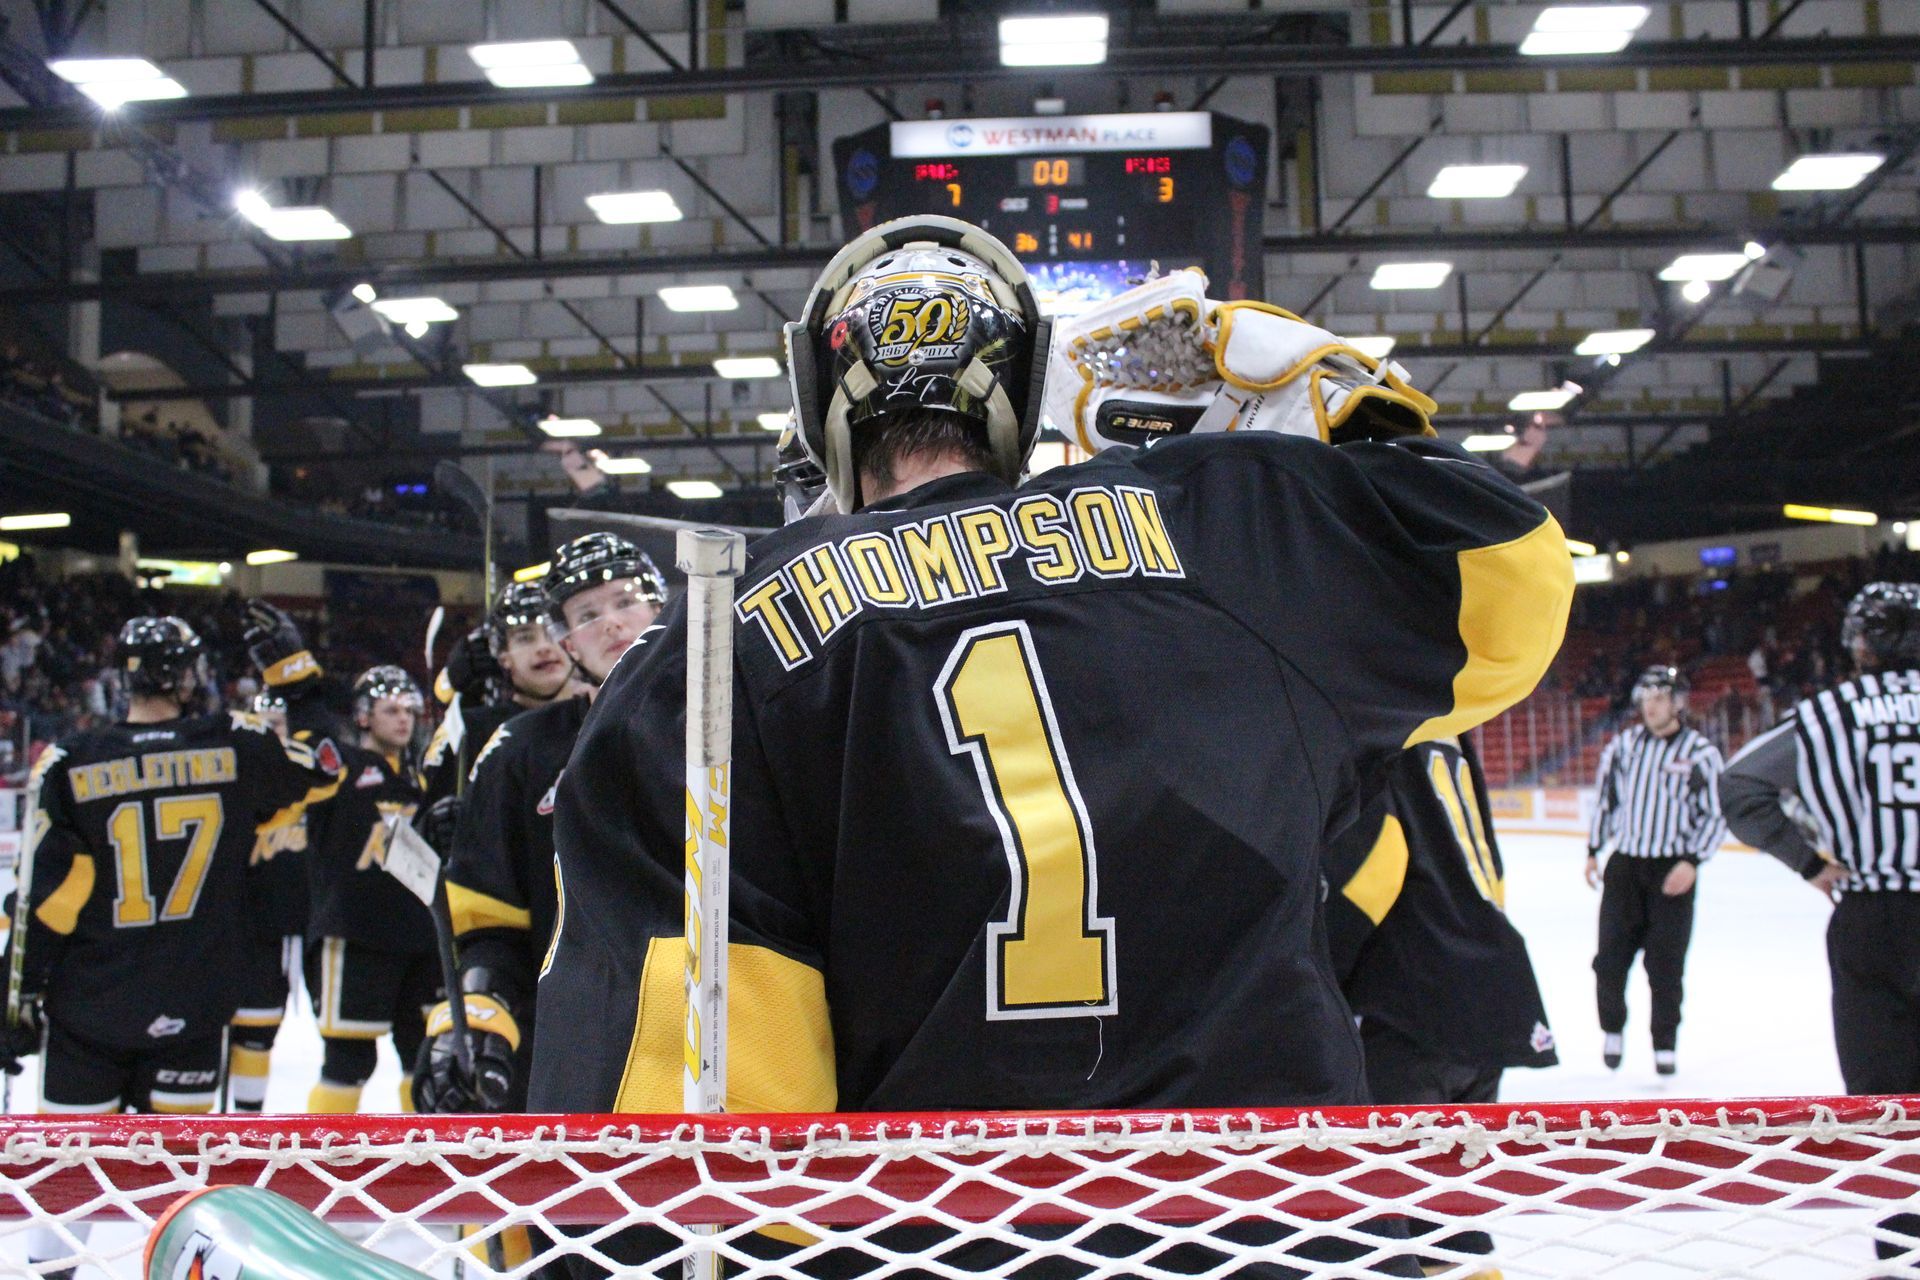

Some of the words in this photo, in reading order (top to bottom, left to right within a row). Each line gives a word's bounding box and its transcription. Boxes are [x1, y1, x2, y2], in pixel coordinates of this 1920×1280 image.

[984, 127, 1097, 145] WESTMAN
[1103, 127, 1156, 141] PLACE
[947, 183, 962, 207] 7
[1158, 176, 1175, 203] 3
[870, 293, 893, 336] WHEAT
[879, 297, 952, 348] 50
[881, 345, 908, 358] 1967
[920, 346, 949, 357] 2017
[715, 538, 738, 577] 1
[733, 485, 1186, 672] THOMPSON
[1850, 693, 1920, 728] MAHO
[1868, 742, 1920, 804] 13
[708, 763, 729, 849] CM
[932, 619, 1118, 1022] 1
[106, 792, 225, 928] 17
[684, 783, 703, 1086] CCM
[156, 1069, 216, 1085] CCM
